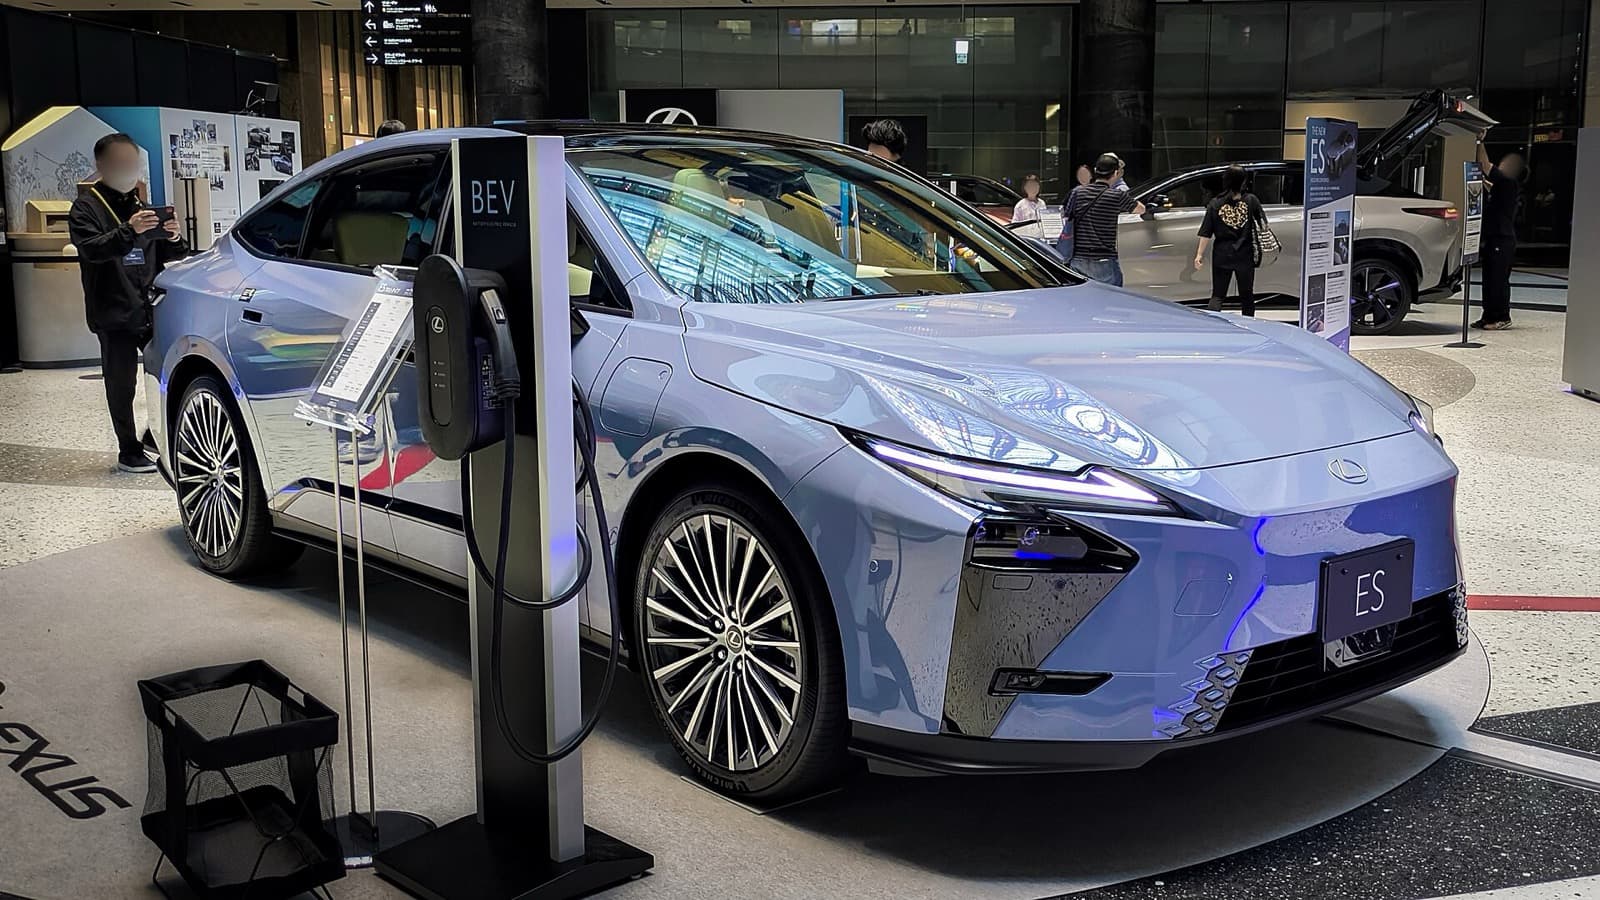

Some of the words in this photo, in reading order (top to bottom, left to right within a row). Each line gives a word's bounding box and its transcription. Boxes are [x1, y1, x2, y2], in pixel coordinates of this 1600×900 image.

[179, 140, 194, 149] LEXUS
[179, 150, 201, 159] Electrified
[1310, 138, 1326, 174] ES
[180, 161, 198, 170] Program
[471, 180, 515, 215] BEV
[1355, 569, 1385, 617] ES
[0, 722, 133, 820] EXUS
[685, 756, 734, 790] MICHELIN
